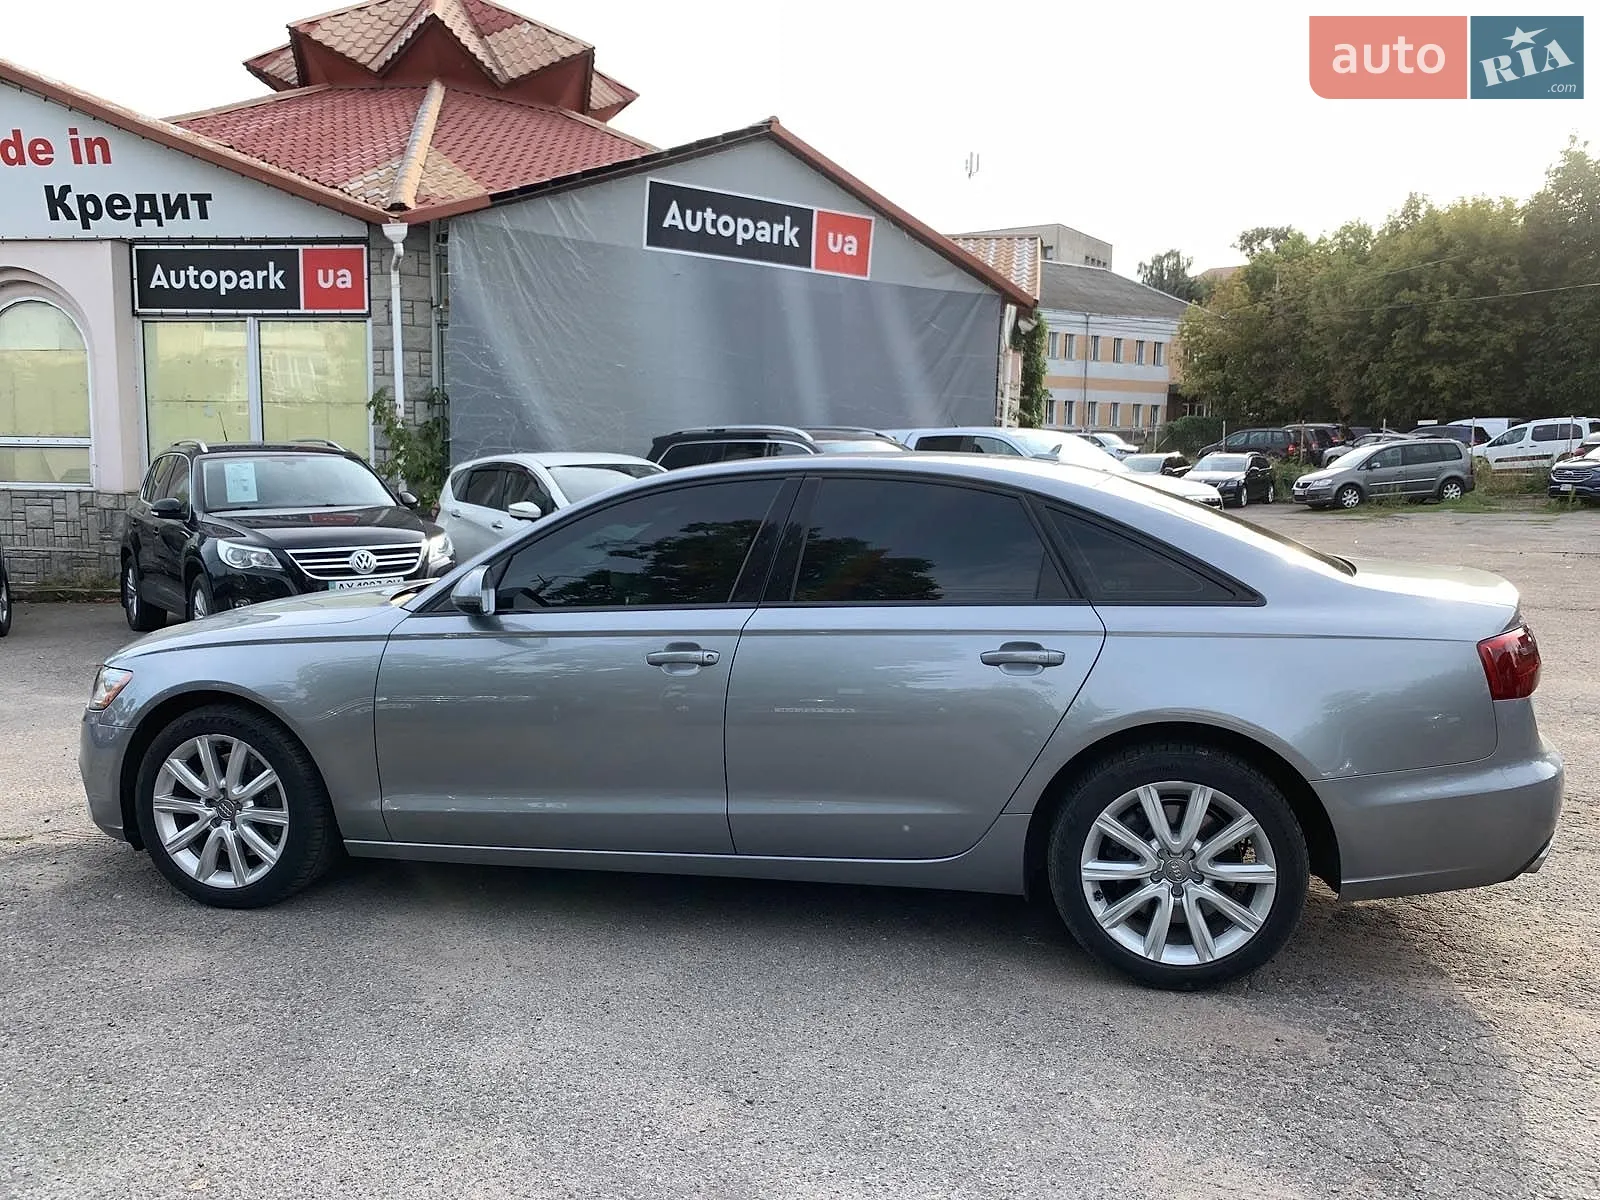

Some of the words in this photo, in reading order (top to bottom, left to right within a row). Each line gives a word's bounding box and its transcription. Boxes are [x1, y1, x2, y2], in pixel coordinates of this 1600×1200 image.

[68, 127, 112, 165] in
[44, 184, 213, 230] Кредит
[662, 200, 800, 248] Autopark
[827, 231, 858, 256] ua
[149, 261, 287, 296] Autopark
[317, 268, 353, 290] ua
